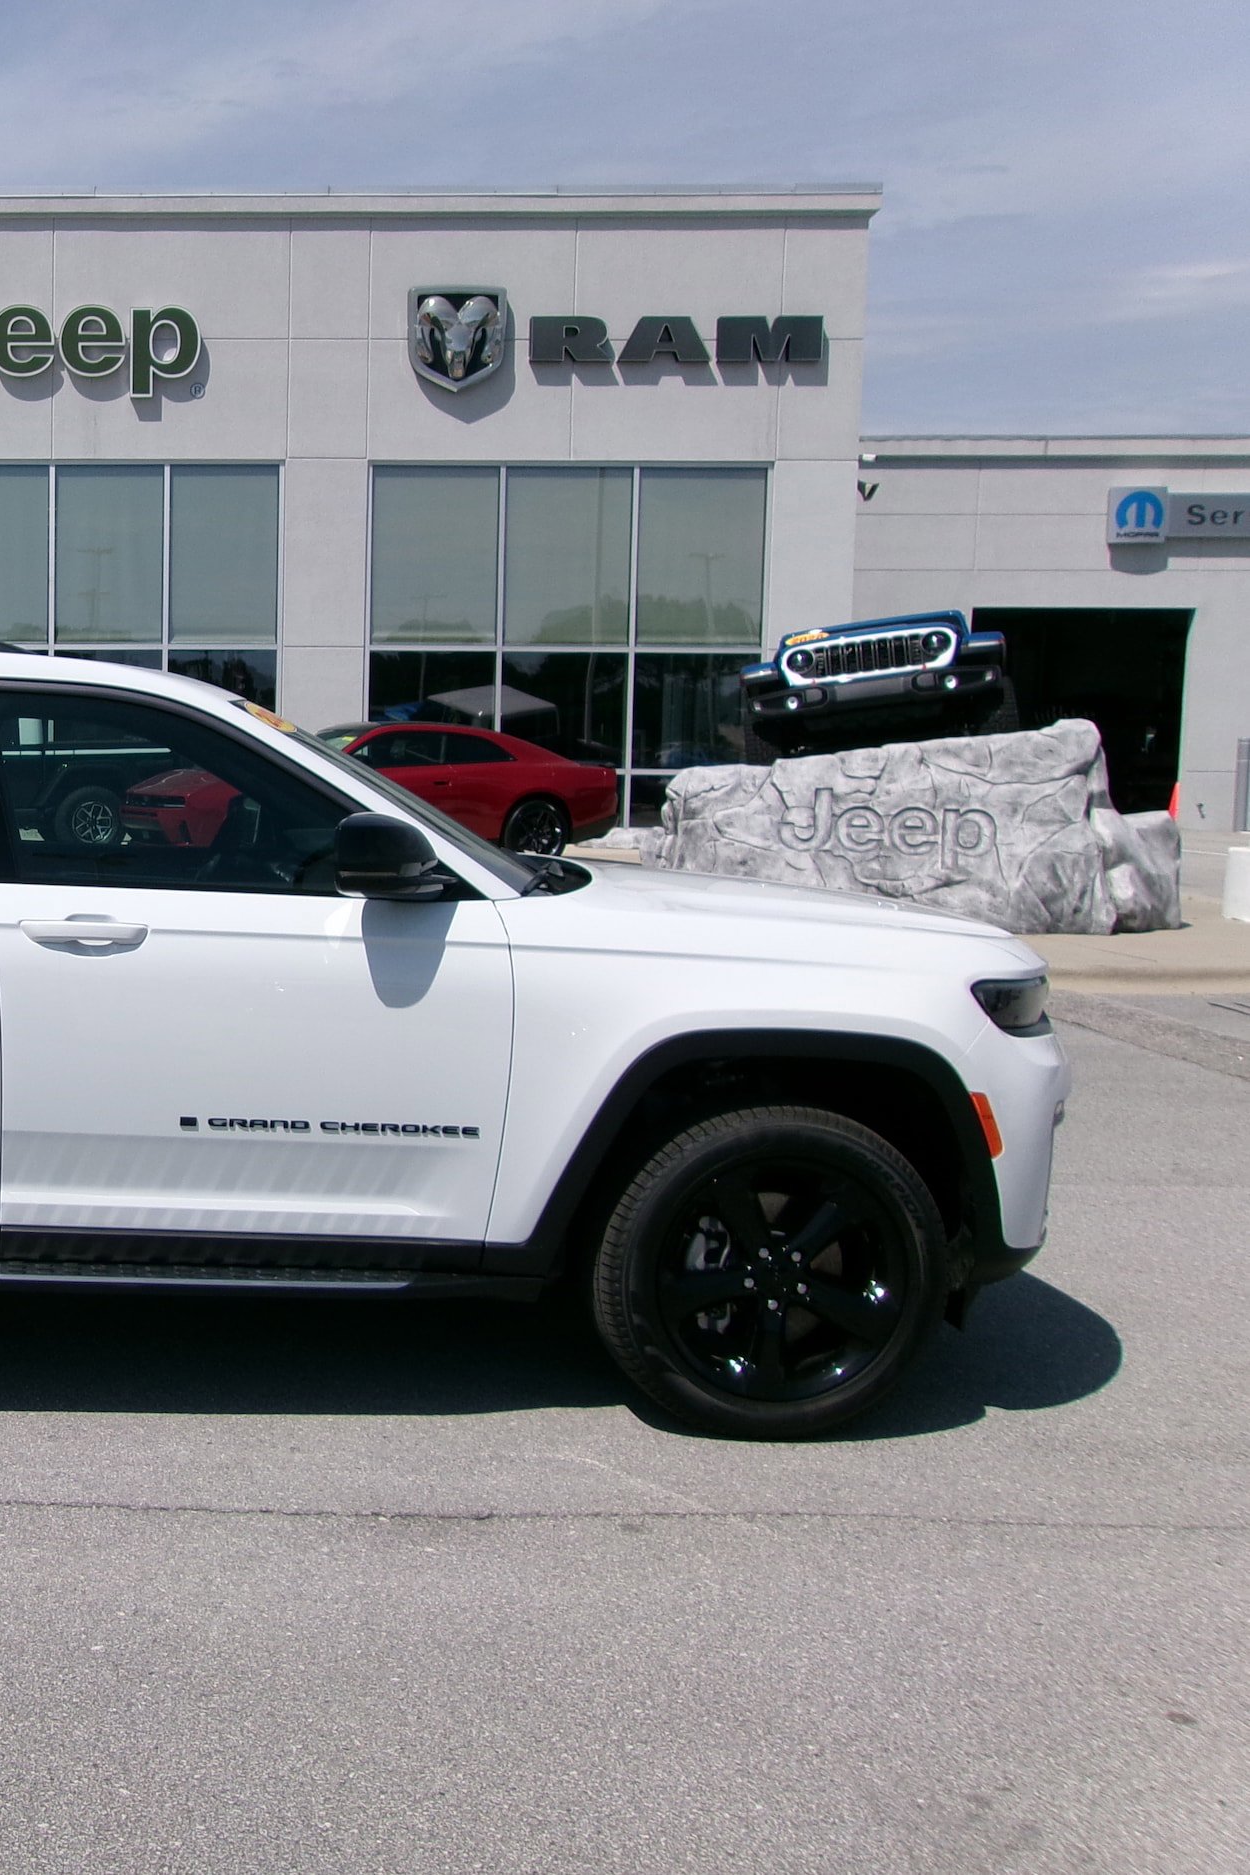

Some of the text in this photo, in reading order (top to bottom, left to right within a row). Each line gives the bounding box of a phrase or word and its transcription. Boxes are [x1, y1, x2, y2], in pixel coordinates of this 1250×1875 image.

[529, 315, 825, 363] RAM
[1187, 504, 1246, 526] Ser
[778, 787, 998, 870] Jeep
[207, 1116, 480, 1136] GRAND CHEROKEE
